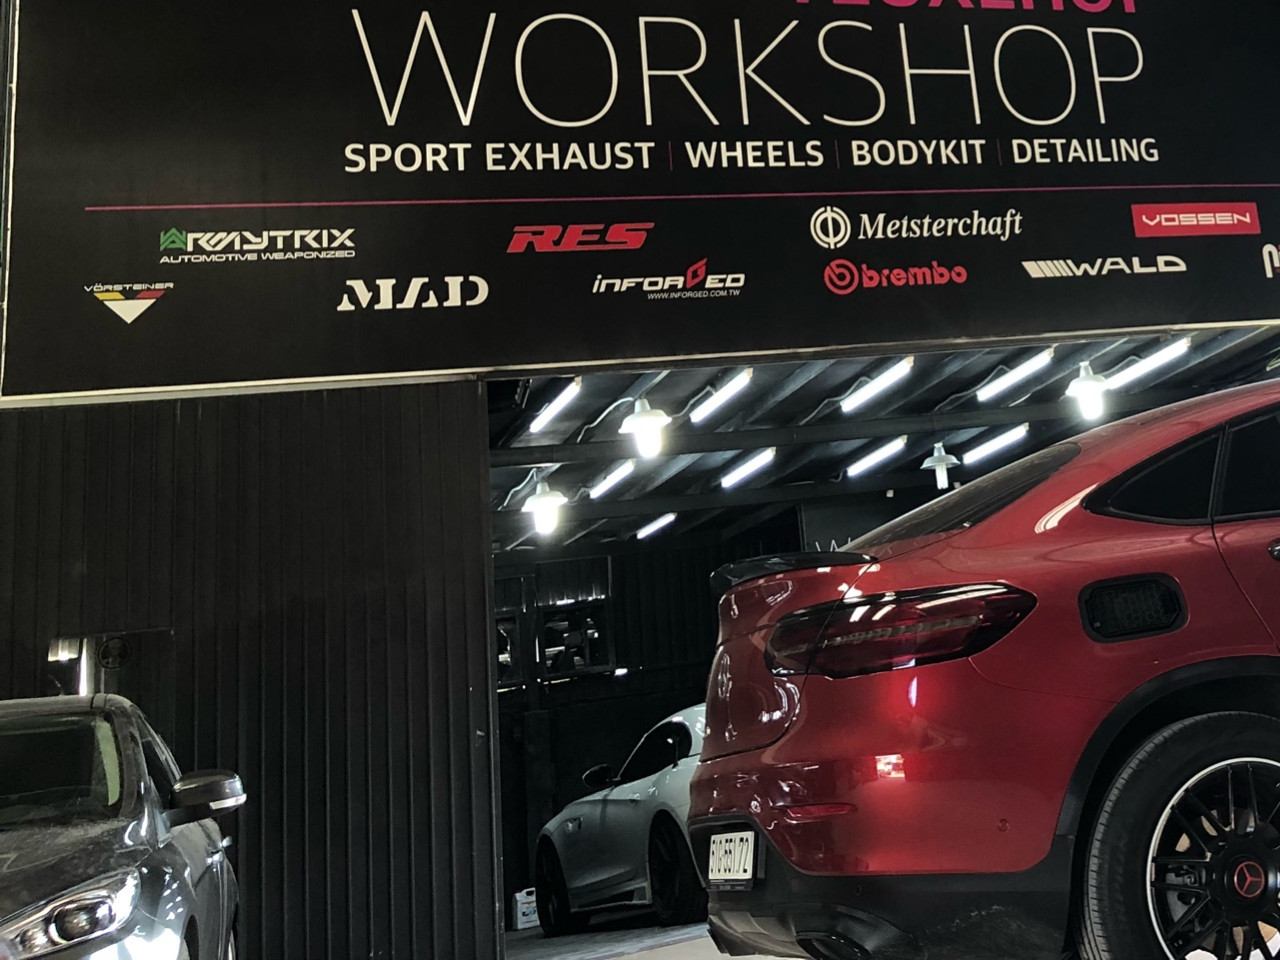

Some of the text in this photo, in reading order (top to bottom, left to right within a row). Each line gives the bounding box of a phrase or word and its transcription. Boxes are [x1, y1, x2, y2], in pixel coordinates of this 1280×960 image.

[351, 8, 1144, 128] WORKSHOP
[344, 137, 1160, 173] SPORT EXHAUST WHEELS BODYKIT DETAILING
[857, 208, 1023, 241] Meisterchaft
[1142, 212, 1251, 226] VOSSEN
[506, 222, 655, 254] RES
[159, 250, 356, 264] AUTOMOTIVE WEAPONIZED
[1066, 255, 1187, 276] WALD
[861, 260, 968, 288] brembo
[336, 275, 489, 311] MAD
[647, 289, 741, 300] WWW.INFORGED.COM.TW
